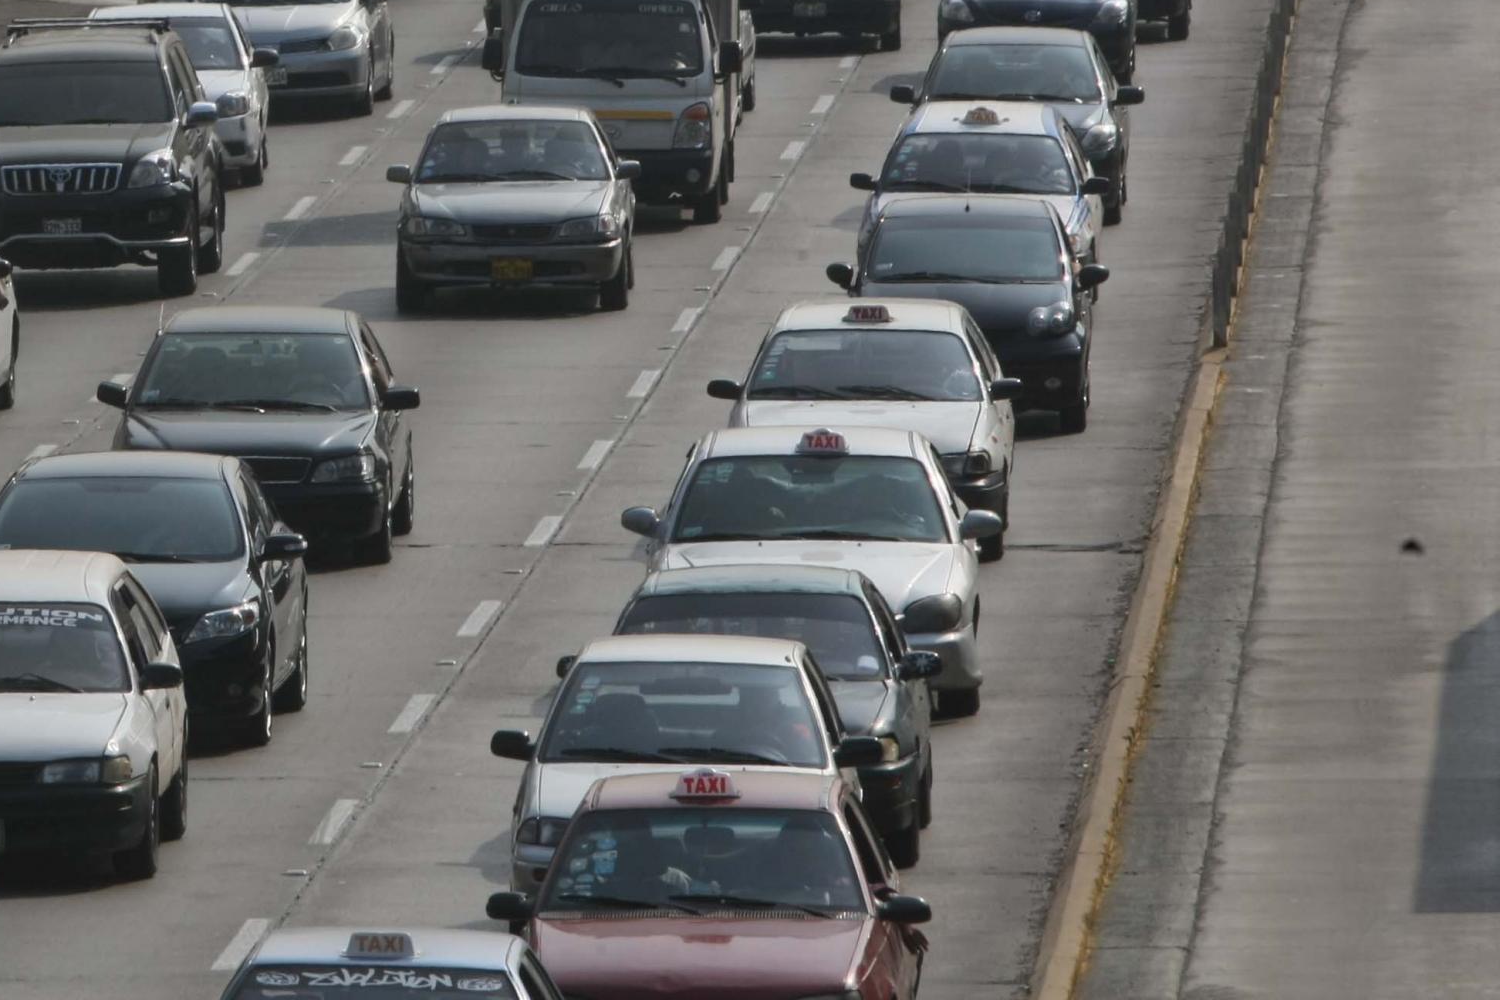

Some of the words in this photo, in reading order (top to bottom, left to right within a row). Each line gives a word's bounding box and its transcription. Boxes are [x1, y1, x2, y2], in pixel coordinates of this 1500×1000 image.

[971, 111, 996, 121] TAXI
[853, 309, 882, 319] TAXI
[806, 436, 838, 449] TAXI
[683, 778, 726, 793] TAXI
[357, 936, 405, 953] TAXI
